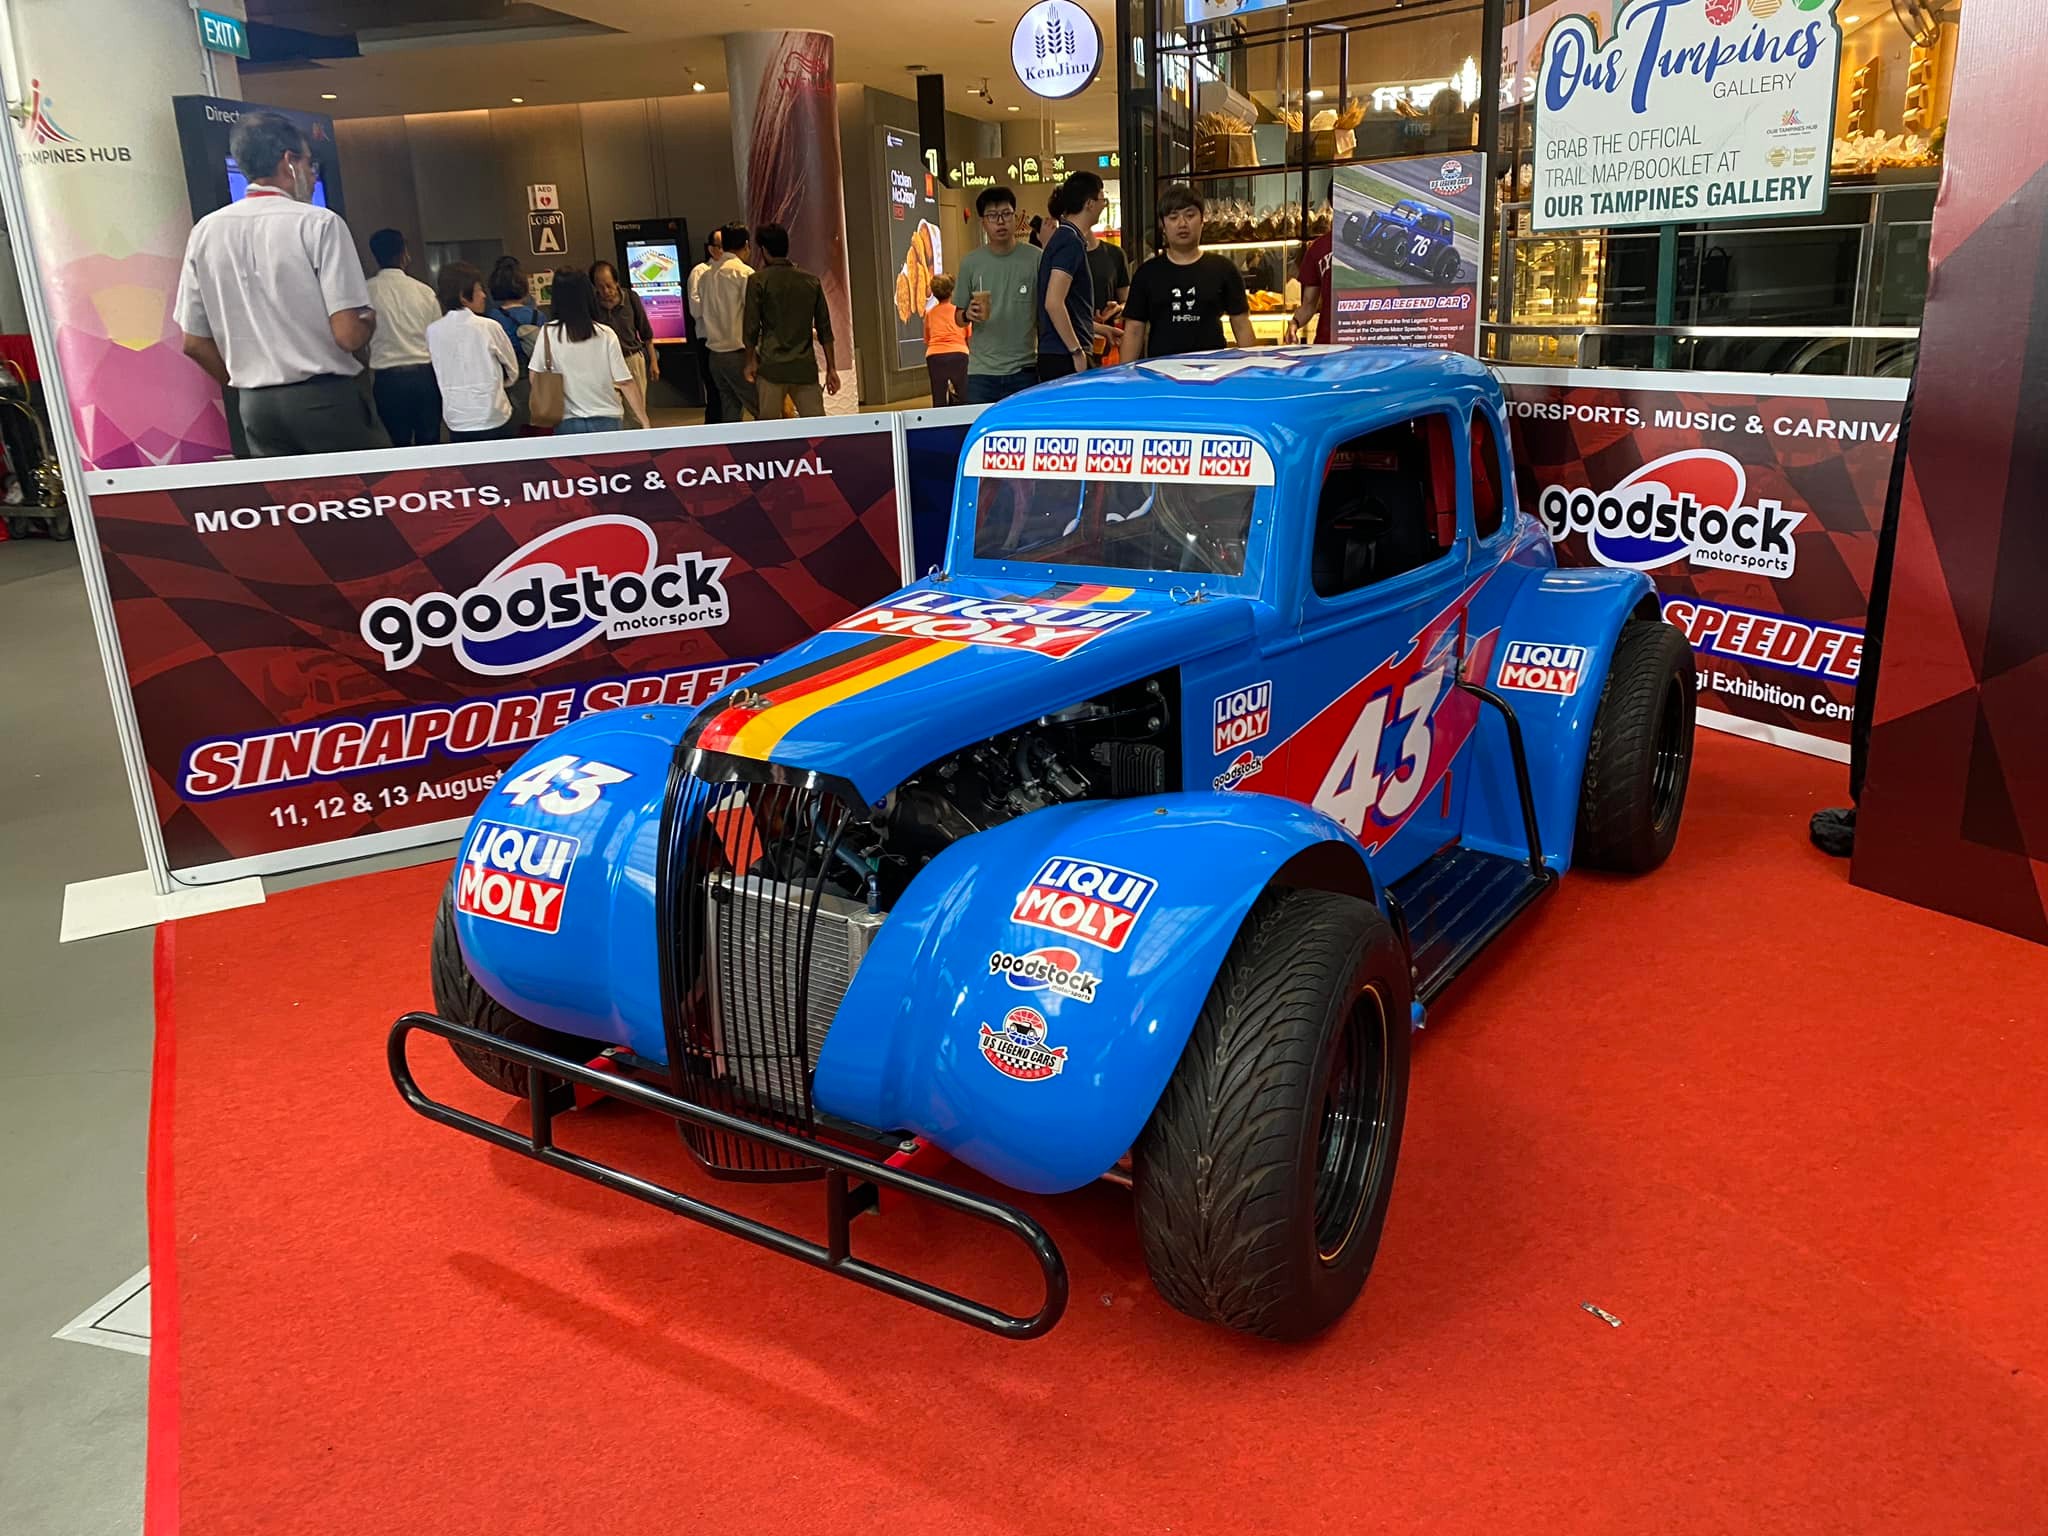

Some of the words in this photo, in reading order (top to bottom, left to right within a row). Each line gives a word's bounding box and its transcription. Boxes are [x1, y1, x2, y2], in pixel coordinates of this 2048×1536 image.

[203, 17, 233, 48] EXIT
[1025, 62, 1091, 81] KenJinn
[1545, 28, 1626, 112] Our
[1625, 0, 1826, 114] Tampines
[1713, 72, 1797, 99] GALLERY
[205, 105, 240, 123] Direct
[90, 147, 131, 162] HUB
[1546, 136, 1588, 160] GRAB
[1593, 133, 1622, 155] THE
[1628, 125, 1702, 152] OFFICIAL
[966, 176, 988, 187] Lobby
[989, 175, 996, 185] A
[1545, 168, 1586, 188] TRAIL
[1592, 153, 1714, 185] MAP/BOOKLET
[1717, 150, 1741, 172] AT
[1544, 196, 1584, 218] OUR
[1590, 185, 1698, 215] TAMPINES
[1707, 175, 1813, 207] GALLERY
[530, 215, 562, 226] LOBBY
[539, 227, 561, 251] A
[1411, 235, 1431, 257] 76
[1338, 300, 1369, 312] WHAT
[1369, 299, 1381, 311] IS
[1381, 299, 1391, 310] A
[1392, 297, 1436, 310] LEGEND
[1505, 401, 1646, 428] TORSPORTS,
[1654, 409, 1736, 433] MUSIC
[1744, 414, 1764, 434] &
[985, 437, 1025, 454] LIQUI
[1035, 438, 1078, 455] LIQUI
[1088, 438, 1132, 456] LIQUI
[1142, 440, 1190, 457] LIQUI
[1201, 440, 1251, 459] LIQUI
[984, 453, 1025, 470] MOLY
[1034, 455, 1076, 472] MOLY
[1087, 456, 1132, 474] MOLY
[1141, 457, 1189, 474] MOLY
[1200, 458, 1250, 476] MOLY
[194, 483, 511, 534] MOTORSPORTS,
[522, 473, 632, 503] MUSIC
[644, 471, 666, 490] &
[676, 456, 833, 488] CARNIVAL
[1543, 490, 1795, 555] goodstock
[1696, 548, 1788, 571] motorsports
[368, 559, 723, 660] goodstock
[613, 606, 723, 633] motorsports
[891, 594, 1132, 628] LIQUI
[837, 610, 1087, 648] MOLY
[1508, 645, 1581, 668] LIQUI
[1501, 665, 1577, 692] MOLY
[1712, 673, 1804, 711] Exhibition
[1217, 685, 1268, 724] LIQUI
[184, 687, 573, 796] SINGAPORE
[1217, 710, 1268, 750] MOLY
[1311, 666, 1444, 836] 43
[270, 805, 309, 830] 11,
[314, 798, 345, 820] 12
[352, 792, 372, 813] &
[379, 786, 408, 809] 13
[416, 770, 504, 803] August
[501, 755, 634, 816] 43
[467, 825, 572, 880] LIQUI
[460, 868, 563, 926] MOLY
[1038, 860, 1147, 909] LIQUI
[1019, 889, 1132, 941] MOLY
[991, 953, 1096, 995] goodstock
[1051, 984, 1091, 1000] motorsports
[983, 1036, 997, 1049] US
[997, 1040, 1030, 1060] LEGEND
[1030, 1051, 1057, 1067] CARS
